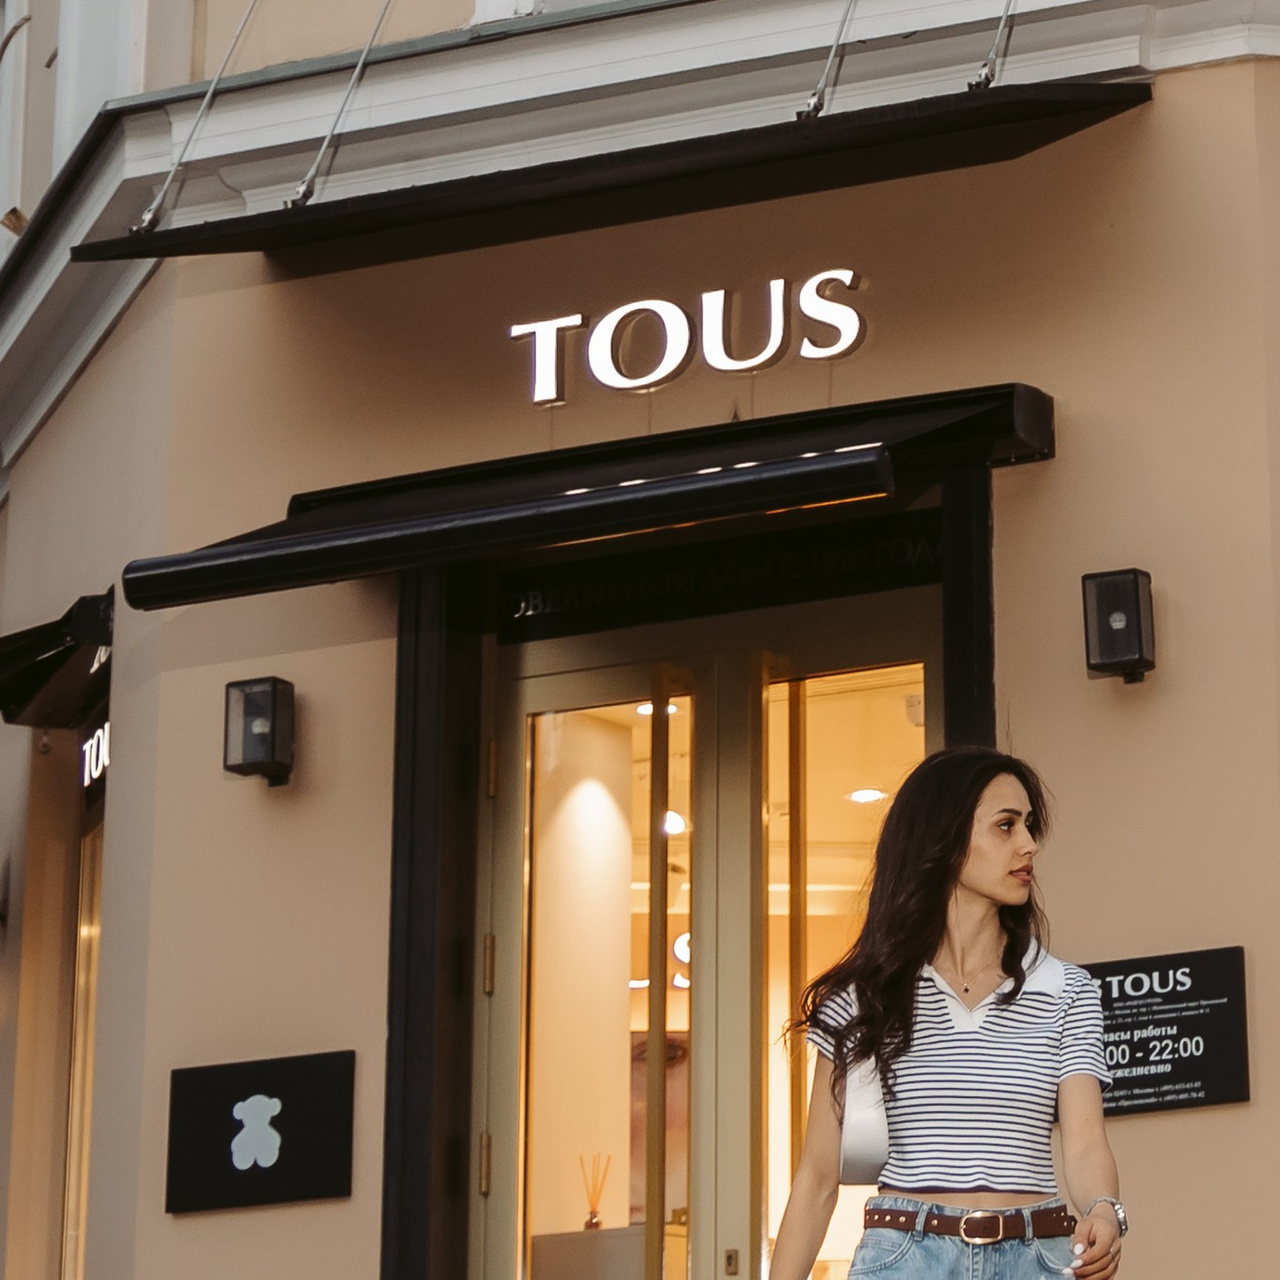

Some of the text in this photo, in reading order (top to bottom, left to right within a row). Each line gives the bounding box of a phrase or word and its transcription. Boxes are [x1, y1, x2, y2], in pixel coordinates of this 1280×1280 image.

[510, 268, 864, 406] TOUS
[1105, 967, 1192, 999] TOUS
[1133, 1024, 1177, 1042] работы
[1148, 1036, 1204, 1061] 22:00
